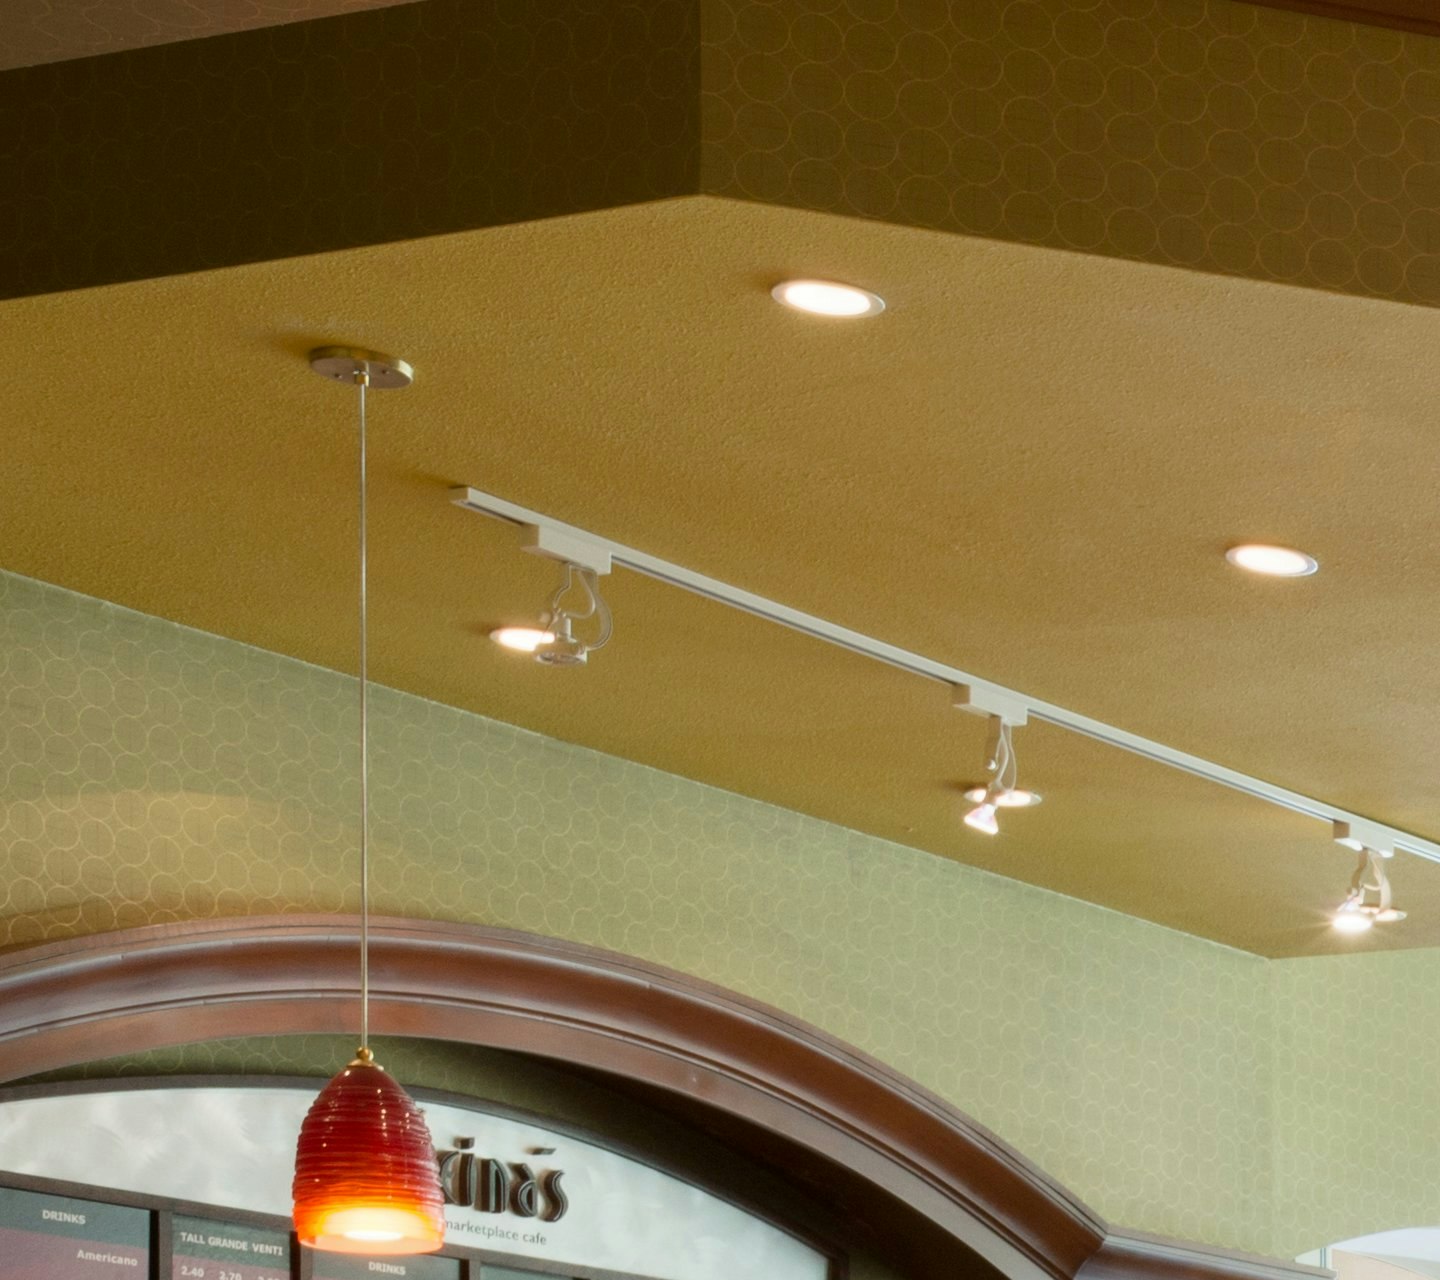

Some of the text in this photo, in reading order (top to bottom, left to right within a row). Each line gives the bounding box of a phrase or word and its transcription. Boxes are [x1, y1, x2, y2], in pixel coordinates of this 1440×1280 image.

[42, 1210, 86, 1225] DRINKS
[180, 1232, 283, 1256] TALL GRANDE VENTI
[76, 1250, 138, 1266] Americano
[181, 1266, 204, 1278] 2.40
[368, 1261, 406, 1276] DRINKS
